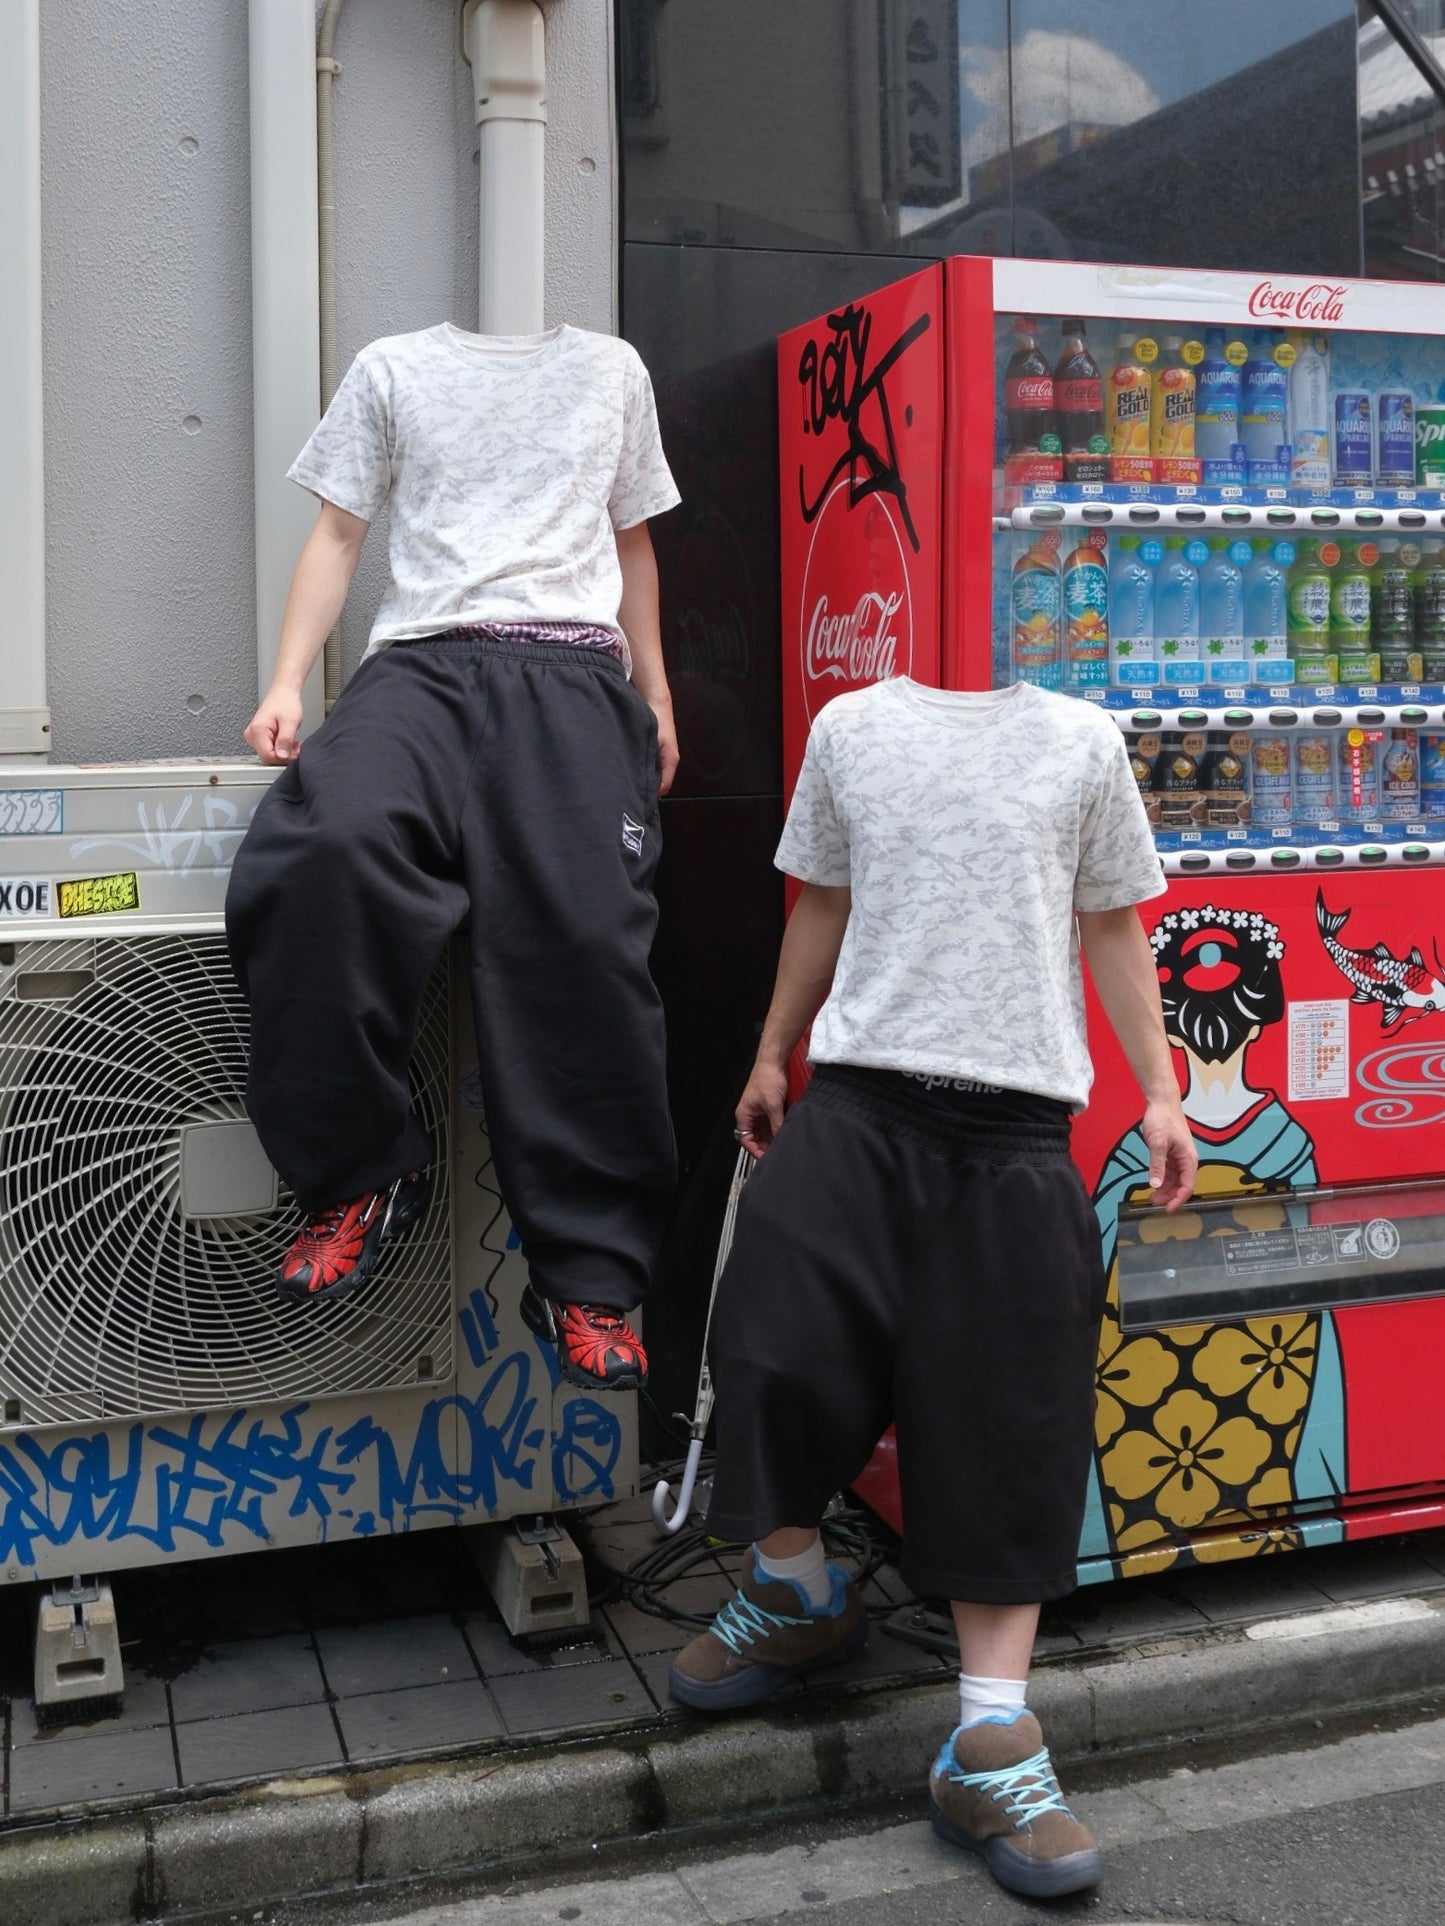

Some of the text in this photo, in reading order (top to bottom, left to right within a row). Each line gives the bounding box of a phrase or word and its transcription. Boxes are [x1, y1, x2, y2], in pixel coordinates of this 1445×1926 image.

[1248, 281, 1348, 321] Coca-Cola
[1117, 400, 1149, 417] GOLD
[1091, 535, 1105, 545] 650
[1067, 582, 1107, 605] 麦茶
[807, 591, 904, 682] Coca-Cola
[1127, 669, 1154, 679] 天然水
[1174, 669, 1200, 679] 天然水
